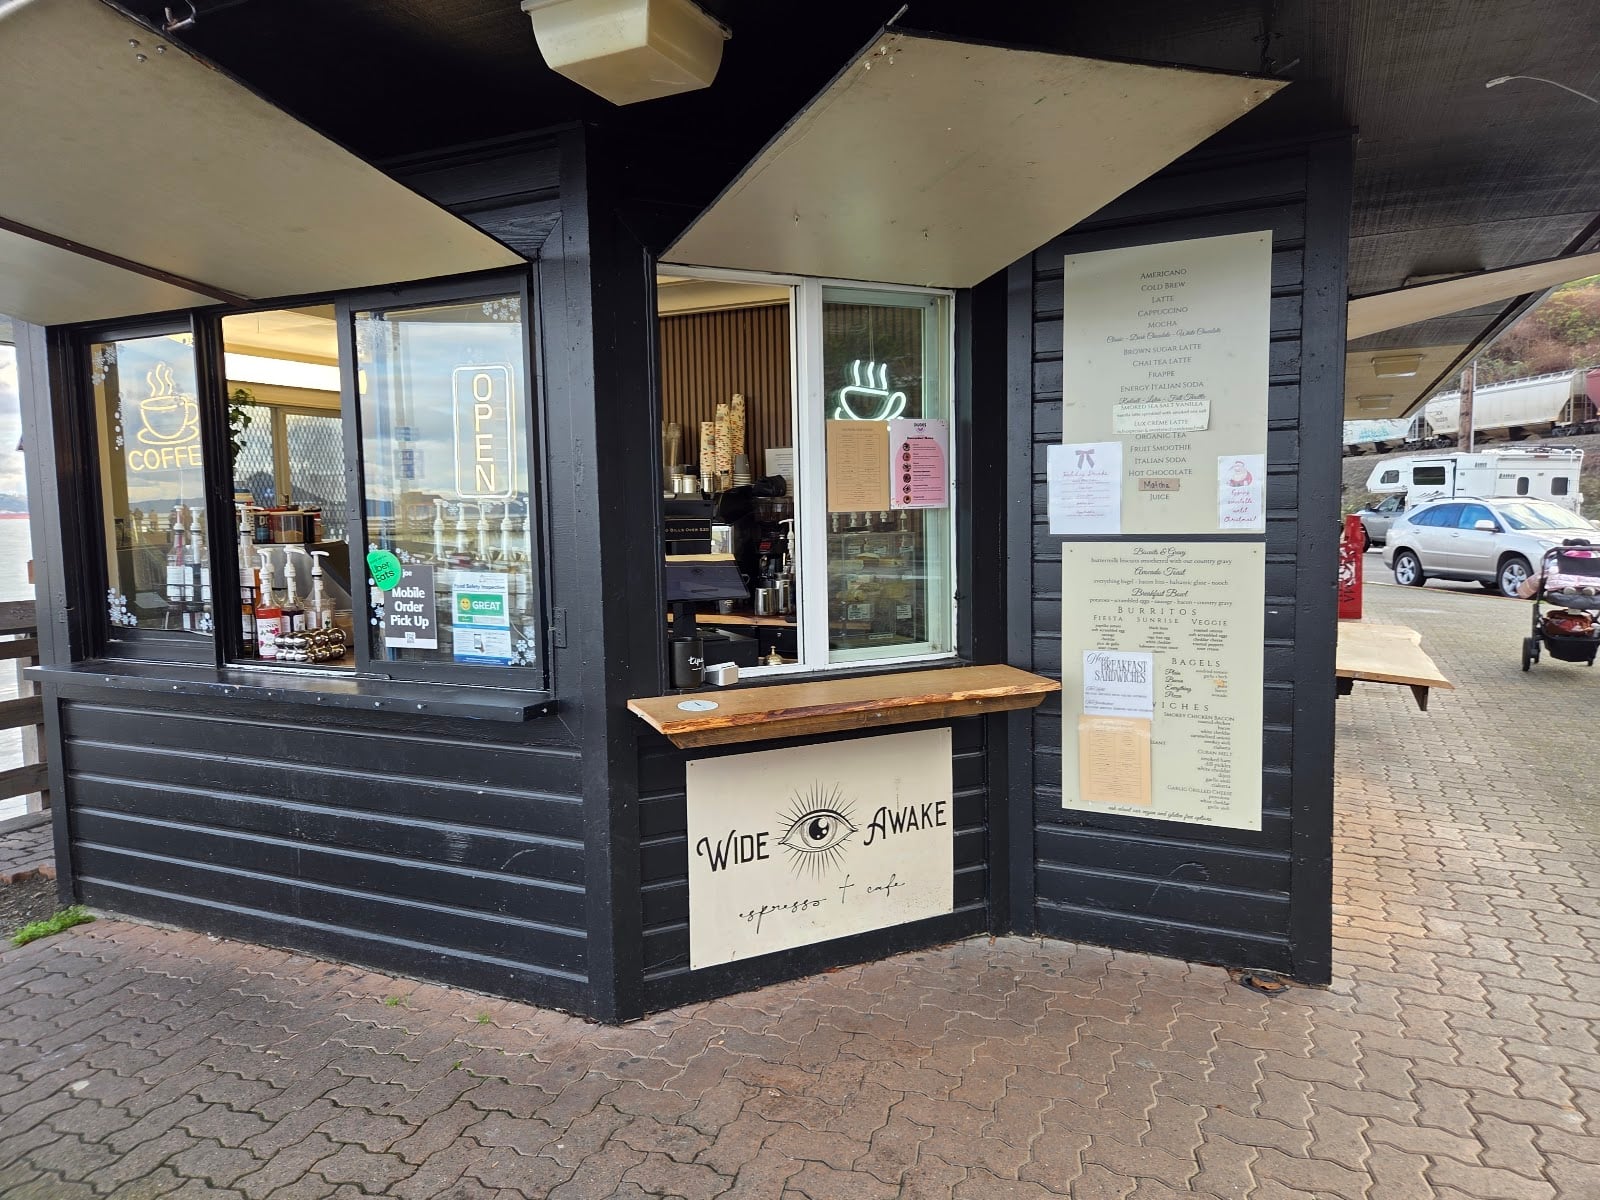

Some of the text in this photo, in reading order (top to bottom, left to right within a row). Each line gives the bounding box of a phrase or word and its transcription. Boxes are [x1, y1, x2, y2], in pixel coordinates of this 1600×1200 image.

[1140, 268, 1187, 279] AMERICANO
[1141, 281, 1186, 292] COLD BREW
[1152, 295, 1174, 303] LATTE
[1137, 306, 1188, 317] CAPPUCCINO
[1147, 320, 1178, 328] MOCHA
[1123, 343, 1202, 356] BROWN SUGAR LATTE
[1169, 357, 1192, 365] LATTE
[1148, 370, 1175, 378] FRAPPE
[1120, 385, 1150, 393] ENERGY
[1151, 383, 1181, 391] ITALIAN
[473, 373, 495, 492] OPEN
[1130, 444, 1191, 453] FRUIT SMOOTHIE
[128, 444, 203, 472] COFFE
[1135, 457, 1164, 465] ITALIAN
[1146, 468, 1193, 476] CHOCOLATE
[1143, 480, 1170, 489] Matcha
[1150, 493, 1169, 501] JUICE
[375, 570, 395, 583] Eats
[402, 568, 413, 579] joe
[1163, 566, 1187, 576] Toast
[392, 586, 426, 598] Mobile
[466, 583, 480, 591] Safety
[1131, 587, 1189, 599] Breakfast Bowl
[394, 601, 424, 613] Order
[472, 600, 501, 611] GREAT
[1117, 606, 1197, 616] BURRITOS
[390, 614, 430, 630] Pick Up
[1093, 614, 1123, 622] FIESTA
[1136, 616, 1179, 624] SUNRISE
[1191, 618, 1228, 627] VEGGIE
[1101, 659, 1147, 673] BREAKFAST
[1171, 657, 1221, 668] BAGELS
[1095, 669, 1146, 684] SANDWICHES
[1164, 711, 1186, 719] SMOKEY
[1186, 713, 1213, 721] CHICKEN
[1167, 784, 1232, 797] GARLIC GRILLED CHEESE
[696, 800, 947, 872] WIDE AWAKE
[739, 898, 828, 935] espresso
[867, 873, 906, 897] cafe
